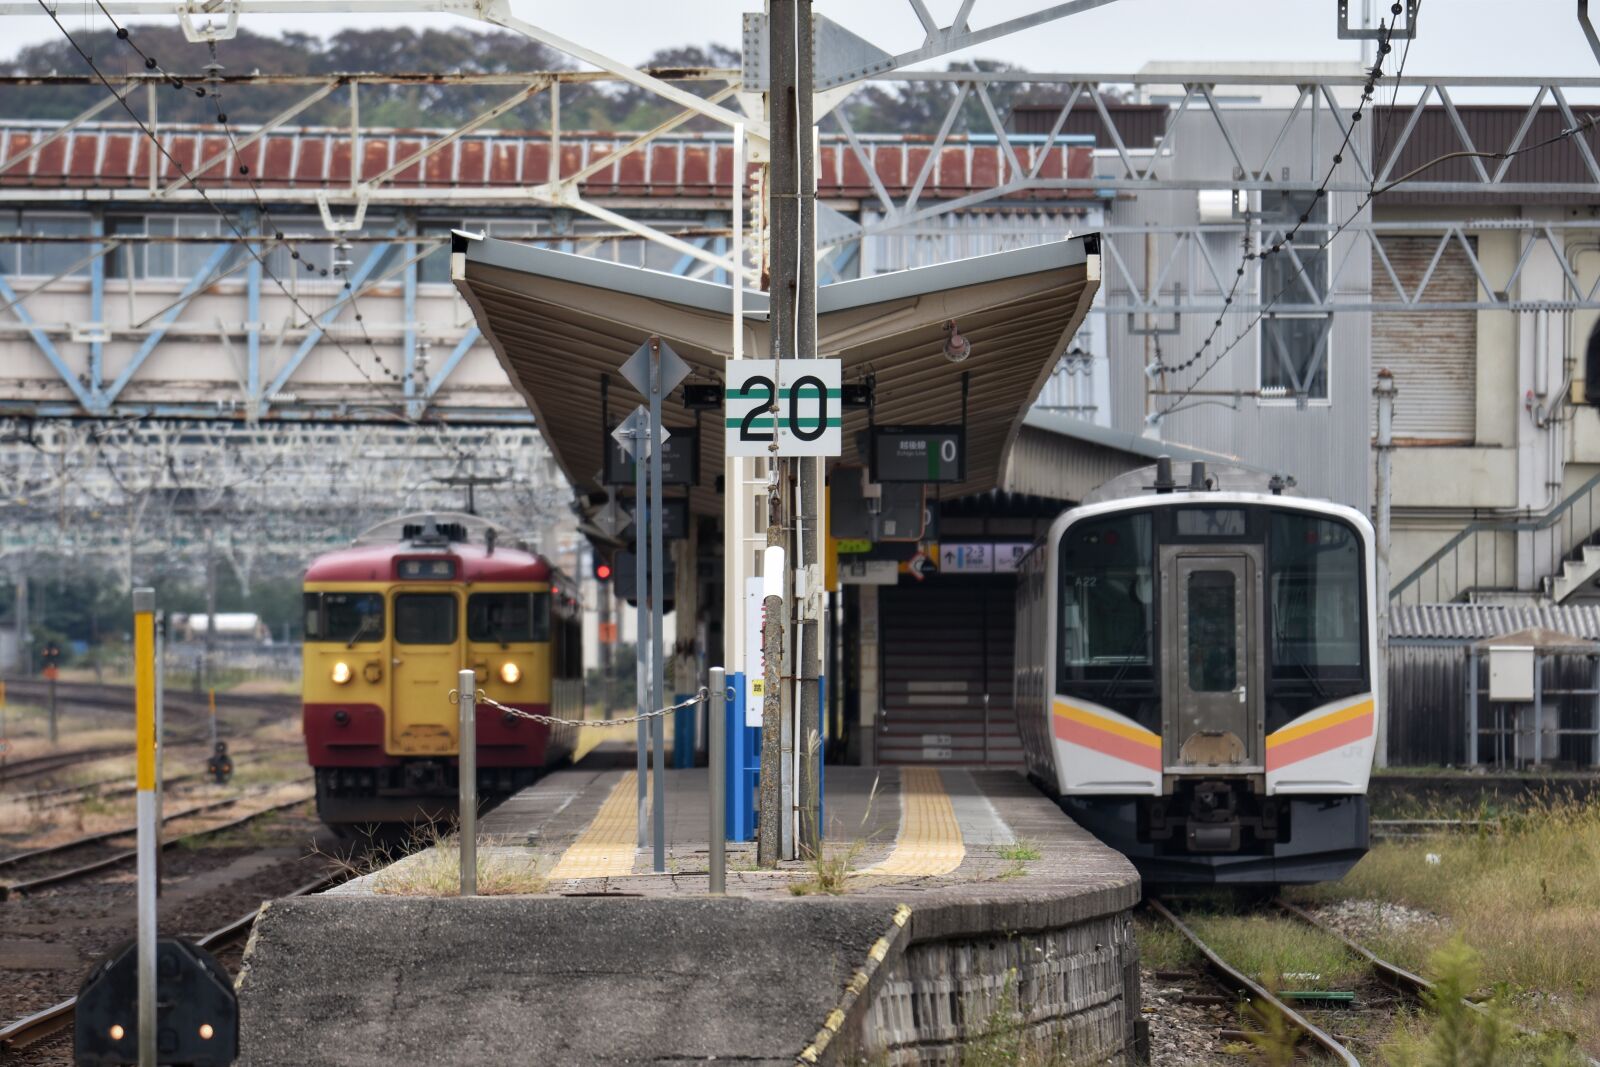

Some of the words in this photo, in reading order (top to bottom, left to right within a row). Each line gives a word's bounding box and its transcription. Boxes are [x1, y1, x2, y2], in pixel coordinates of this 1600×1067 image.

[740, 375, 827, 441] 20
[941, 440, 956, 462] 0
[1075, 576, 1096, 587] A22
